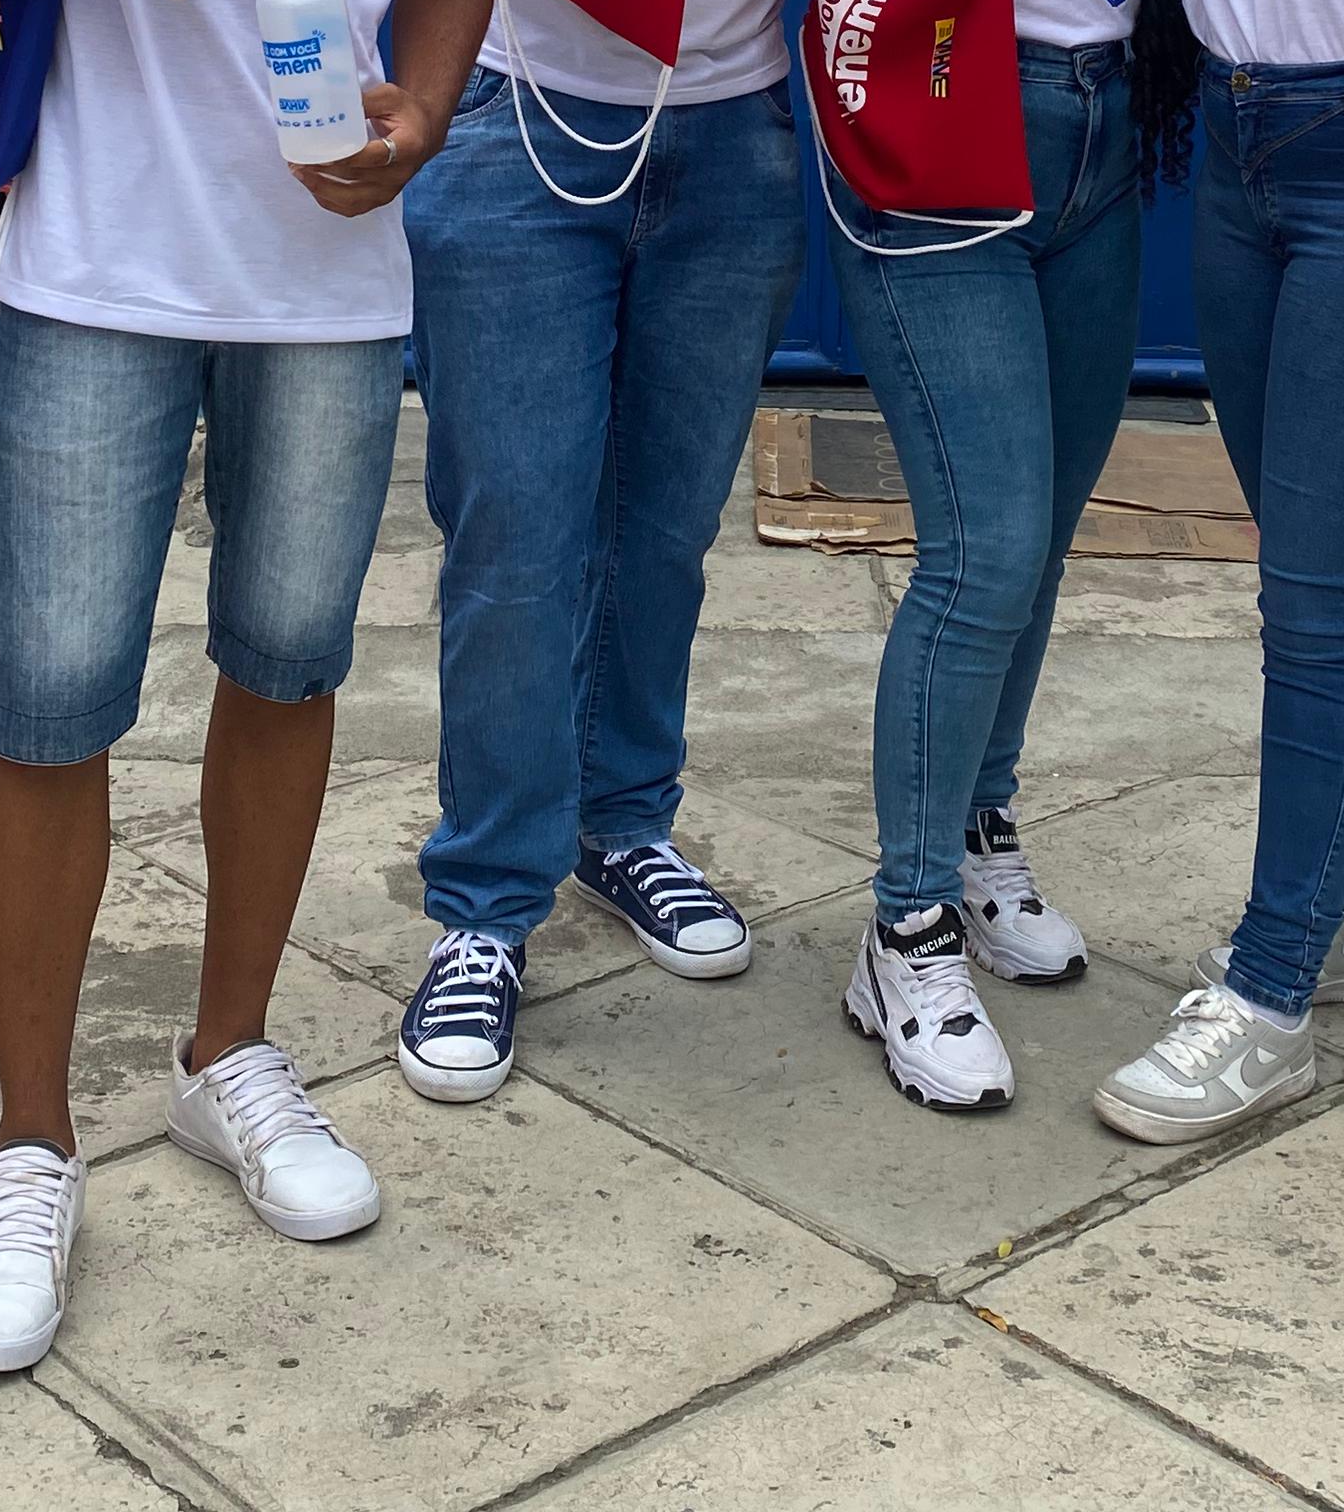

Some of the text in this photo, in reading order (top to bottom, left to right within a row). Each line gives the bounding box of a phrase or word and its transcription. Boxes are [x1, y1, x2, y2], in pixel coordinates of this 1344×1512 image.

[290, 42, 317, 55] VOCÊ
[273, 57, 322, 76] enem
[903, 930, 958, 959] ALENCIAGA
